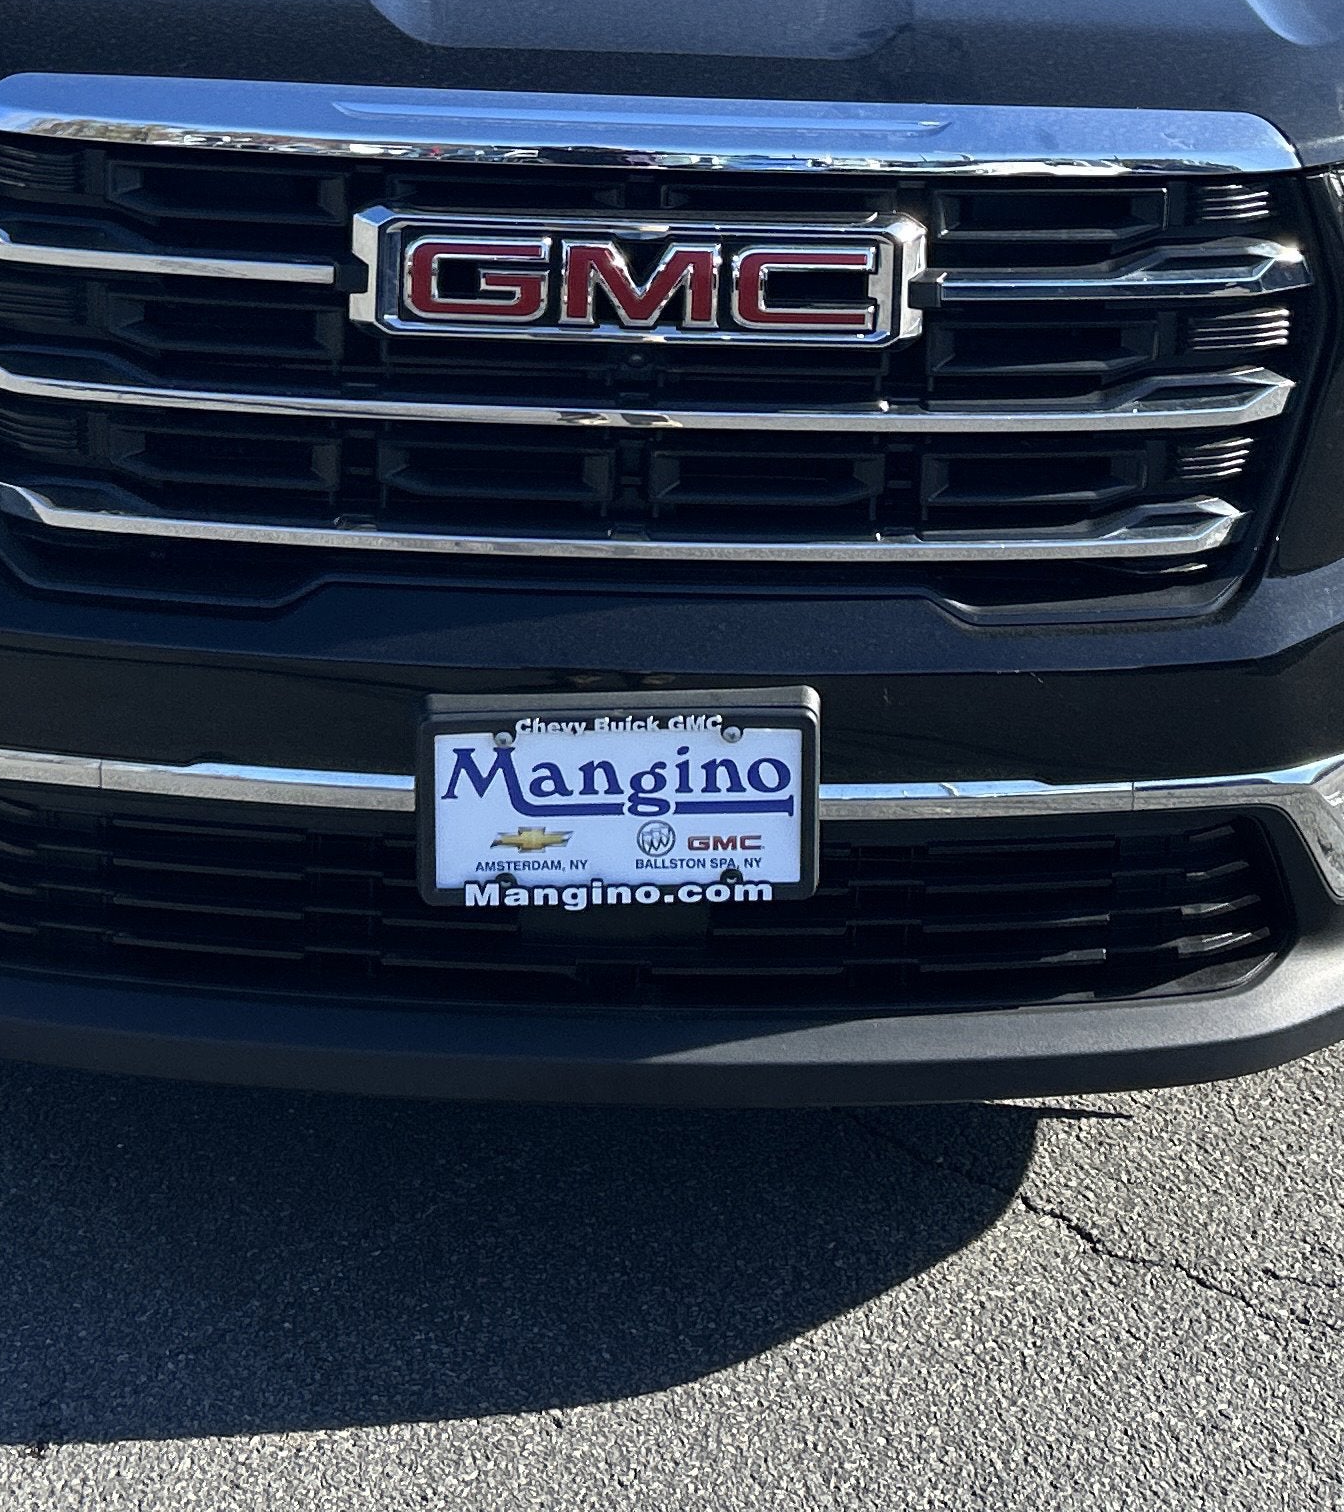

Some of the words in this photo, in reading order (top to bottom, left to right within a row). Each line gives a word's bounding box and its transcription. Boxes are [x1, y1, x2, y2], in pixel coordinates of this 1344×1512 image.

[404, 234, 877, 331] GMC
[515, 717, 586, 735] Chevy
[594, 715, 660, 732] Buick
[668, 714, 722, 731] GMC
[441, 746, 794, 817] Mangino
[687, 834, 762, 851] GMC
[475, 859, 566, 872] AMSTERDAM,
[570, 859, 588, 870] NY
[635, 858, 707, 870] BALLSTON
[744, 857, 762, 869] NY
[464, 878, 773, 910] Mangino.com
